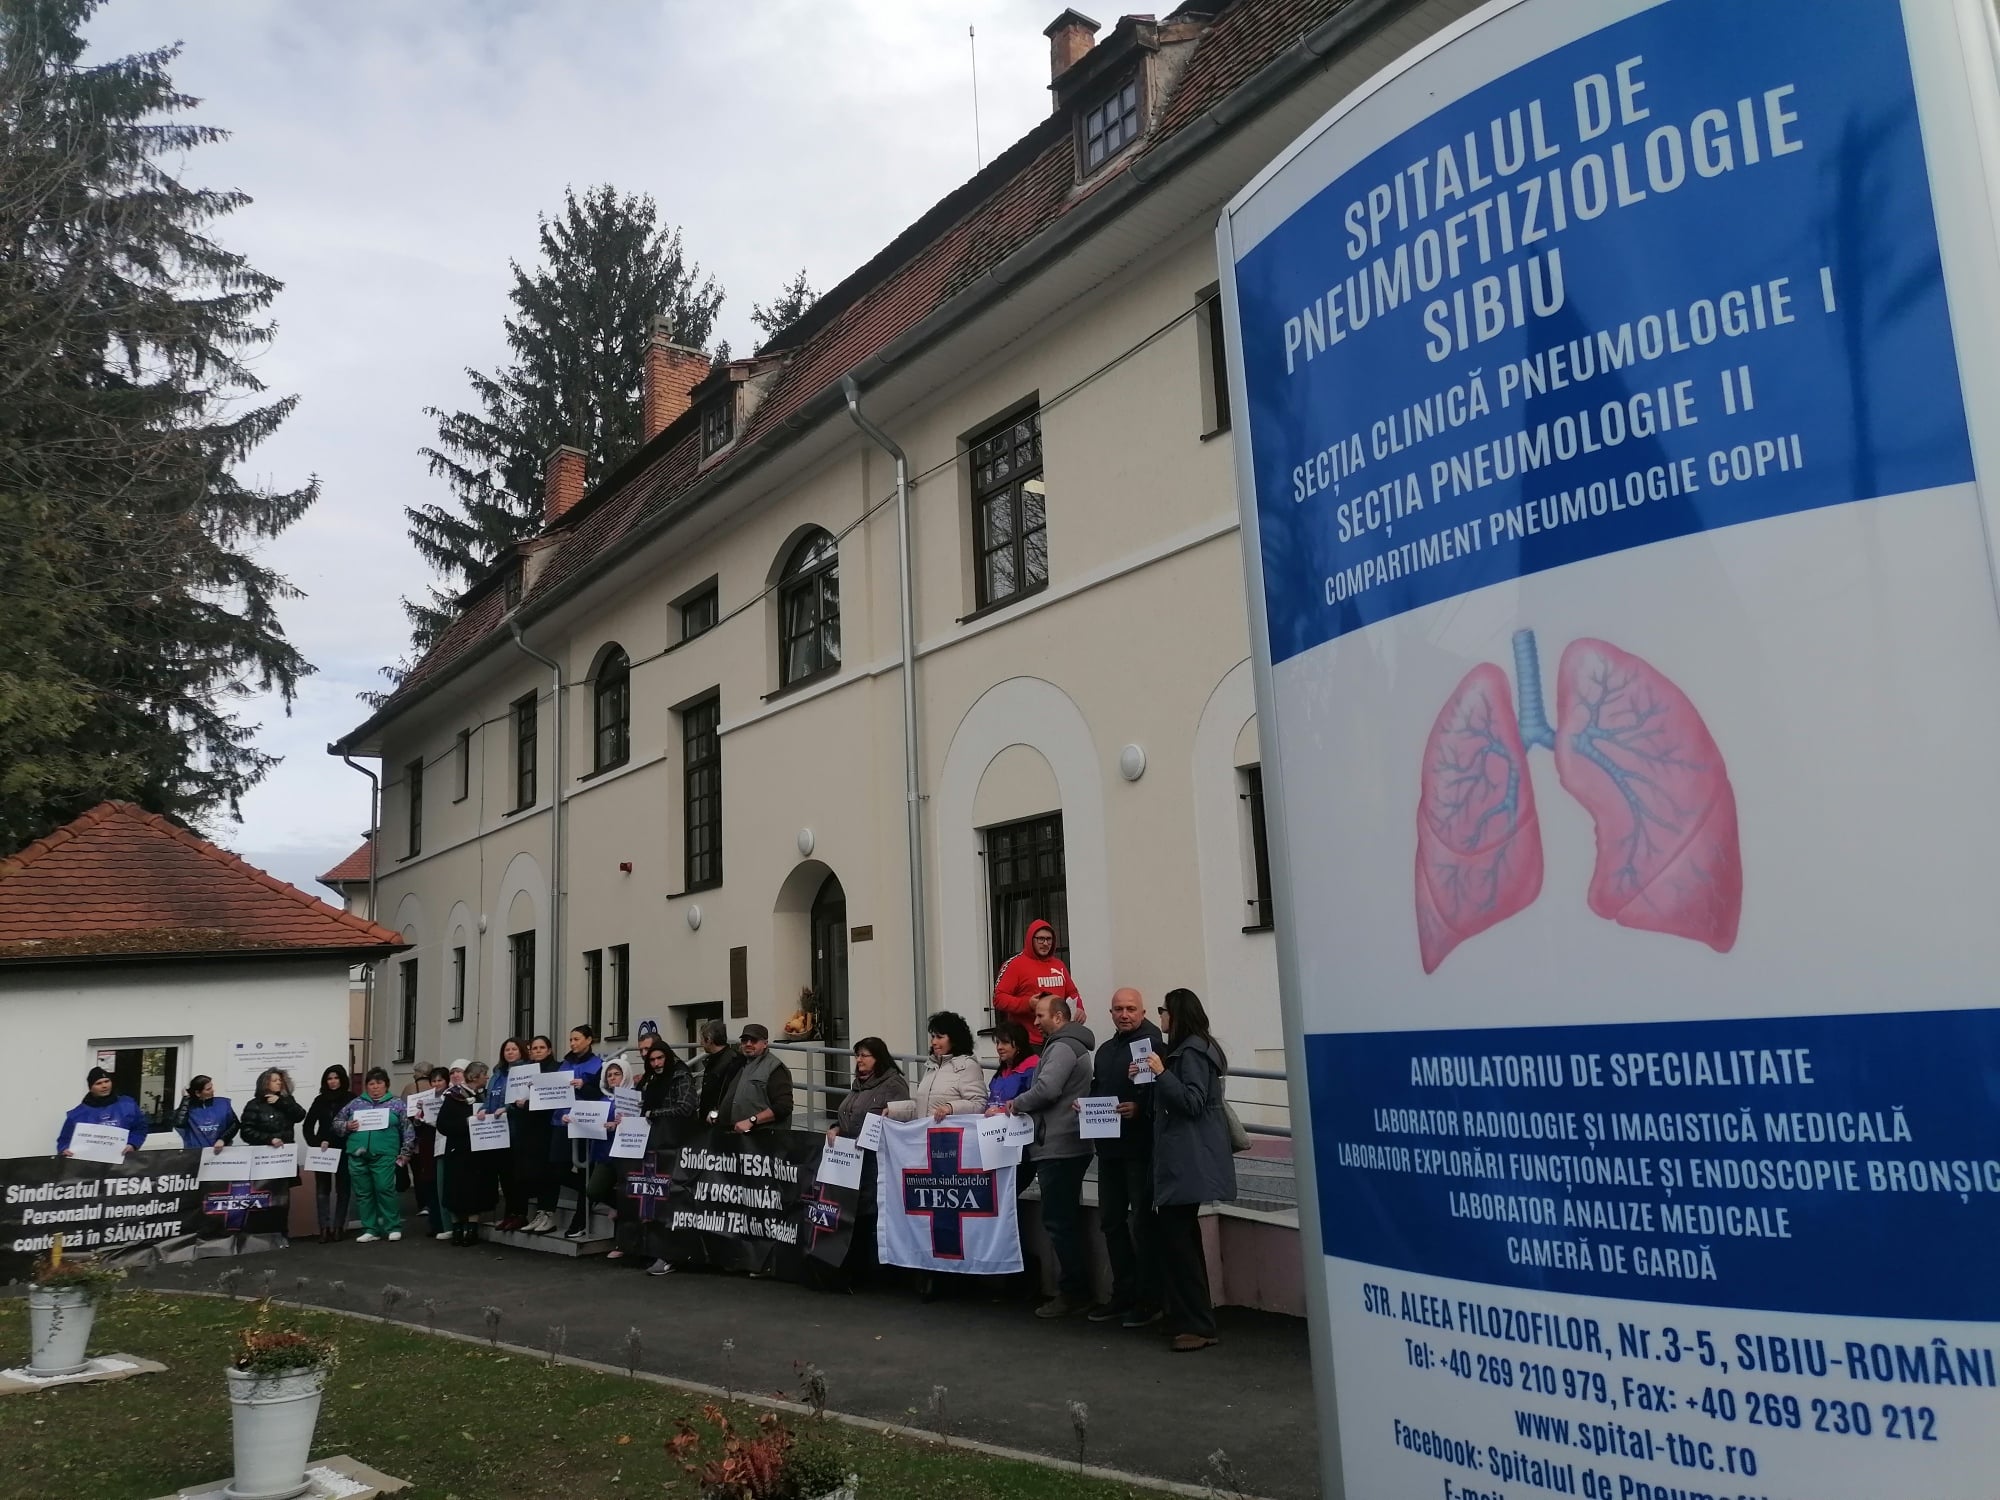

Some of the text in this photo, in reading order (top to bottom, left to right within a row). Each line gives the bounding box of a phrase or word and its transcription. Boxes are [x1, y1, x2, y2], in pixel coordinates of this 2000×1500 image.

[1343, 55, 1650, 261] SPITALUL DE
[1283, 83, 1804, 376] PNEUMOFTIZIOLOGIE
[1423, 248, 1565, 363] SIBIU
[1292, 267, 1836, 503] SECȚIA CLINICĂ PNEUMOLOGIE I
[1336, 365, 1755, 543] SECȚIA PNEUMOLOGIE II
[1325, 433, 1803, 606] COMPARTIMENT PNEUMOLOGIE COPII
[1411, 1048, 1814, 1087] AMBULATORIU DE SPECIALITATE
[1374, 1105, 1912, 1150] LABORATOR RADIOLOGIE ȘI IMAGISTICĂ MEDICALĂ
[6, 1174, 200, 1204] Sindicatul TESA Sibiu
[906, 1174, 990, 1187] uniunea sindicatelor
[1338, 1142, 1411, 1172] LABORATOR
[1414, 1147, 1504, 1180] EXPLORĂRI
[1509, 1153, 1653, 1193] FUNCȚIONALE
[1659, 1158, 1683, 1198] ȘI
[1689, 1158, 1860, 1191] ENDOSCOPIE
[22, 1198, 180, 1225] Personalul nemedical
[213, 1199, 262, 1211] TESA
[914, 1188, 981, 1209] TESA
[1450, 1191, 1792, 1238] LABORATOR ANALIZE MEDICALE
[104, 1221, 182, 1243] SĂNĂTATE
[1507, 1237, 1717, 1280] CAMERĂ DE GARDĂ
[1363, 1282, 1396, 1318] STR.
[1401, 1291, 1454, 1330] ALEEA
[1458, 1301, 1612, 1361] FILOZOFILOR,
[1405, 1338, 1937, 1441] Tel: +40 269 210 979, Fax: +40 269 230 212
[1394, 1419, 1483, 1470] Facebook:
[1488, 1446, 1575, 1494] Spitalul
[1582, 1468, 1612, 1500] de
[1515, 1410, 1757, 1477] www.spital-tbc.ro
